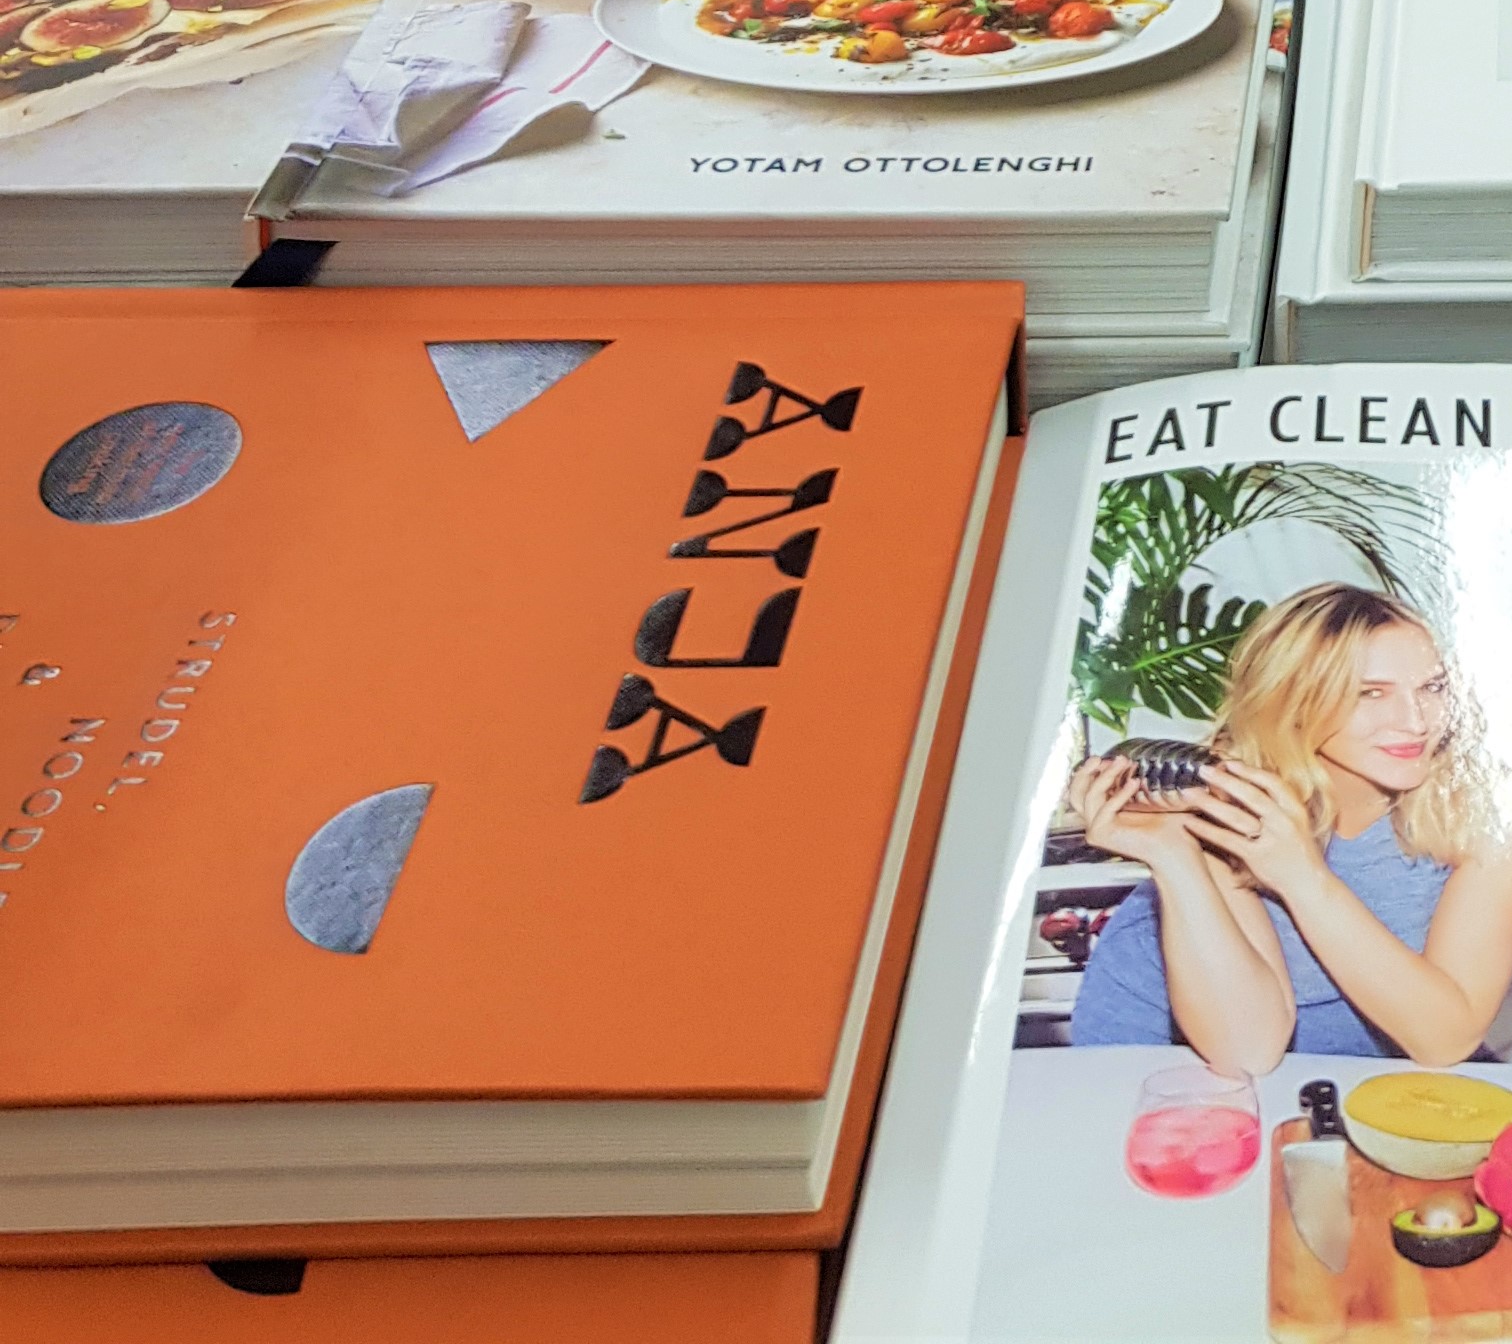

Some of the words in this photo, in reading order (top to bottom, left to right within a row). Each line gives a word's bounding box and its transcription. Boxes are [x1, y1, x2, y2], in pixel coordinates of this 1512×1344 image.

[690, 157, 823, 173] YOTAM
[843, 156, 1094, 173] OTTOLENGHI
[1104, 400, 1232, 465] EAT
[1269, 395, 1492, 448] CLEAN
